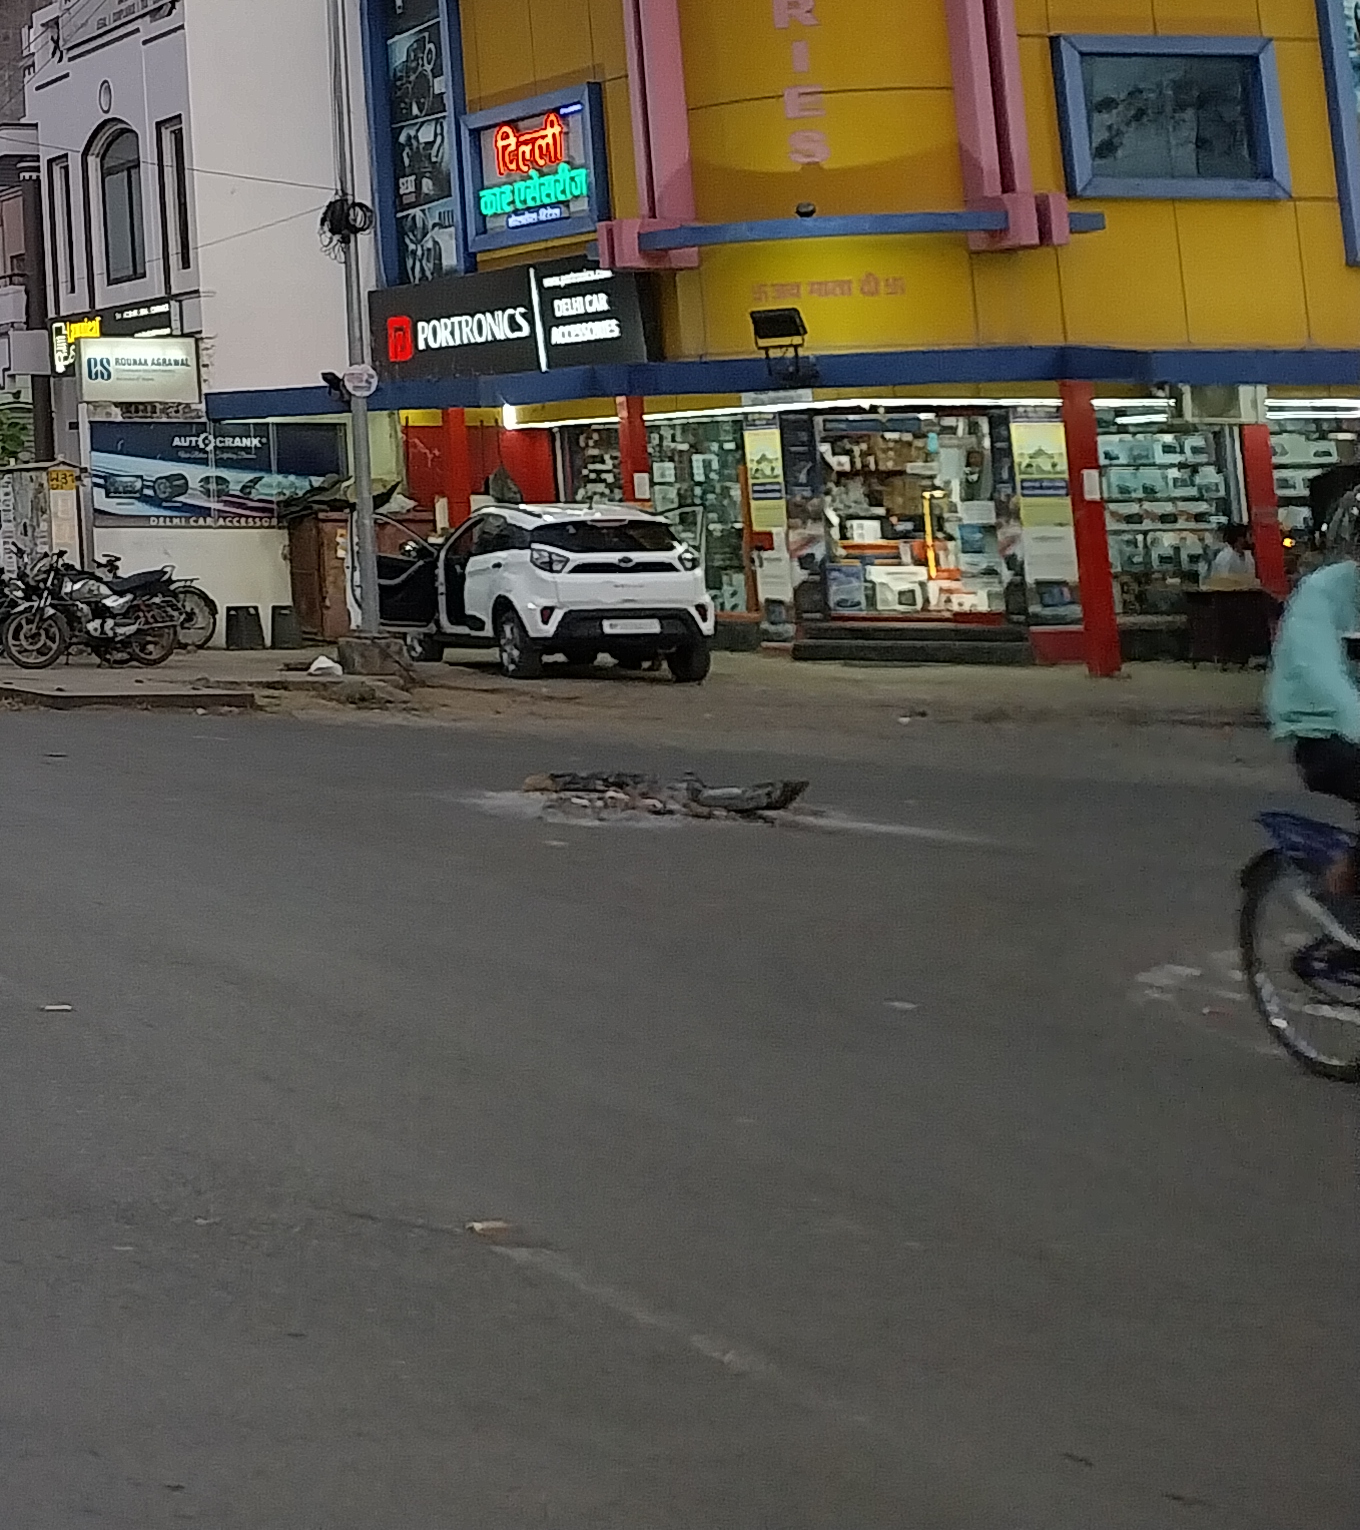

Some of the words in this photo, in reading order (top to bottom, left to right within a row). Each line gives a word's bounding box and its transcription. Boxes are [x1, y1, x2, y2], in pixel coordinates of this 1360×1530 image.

[494, 113, 563, 176] दिल्ली
[479, 183, 513, 215] कार
[807, 278, 853, 298] माता
[859, 271, 879, 298] दी
[553, 296, 586, 318] DELHI
[584, 292, 612, 314] CAR
[417, 307, 531, 351] PORTRONICS
[551, 318, 621, 346] ACCESSORIES
[150, 357, 191, 368] AGRAWAL
[148, 516, 186, 527] DELHI
